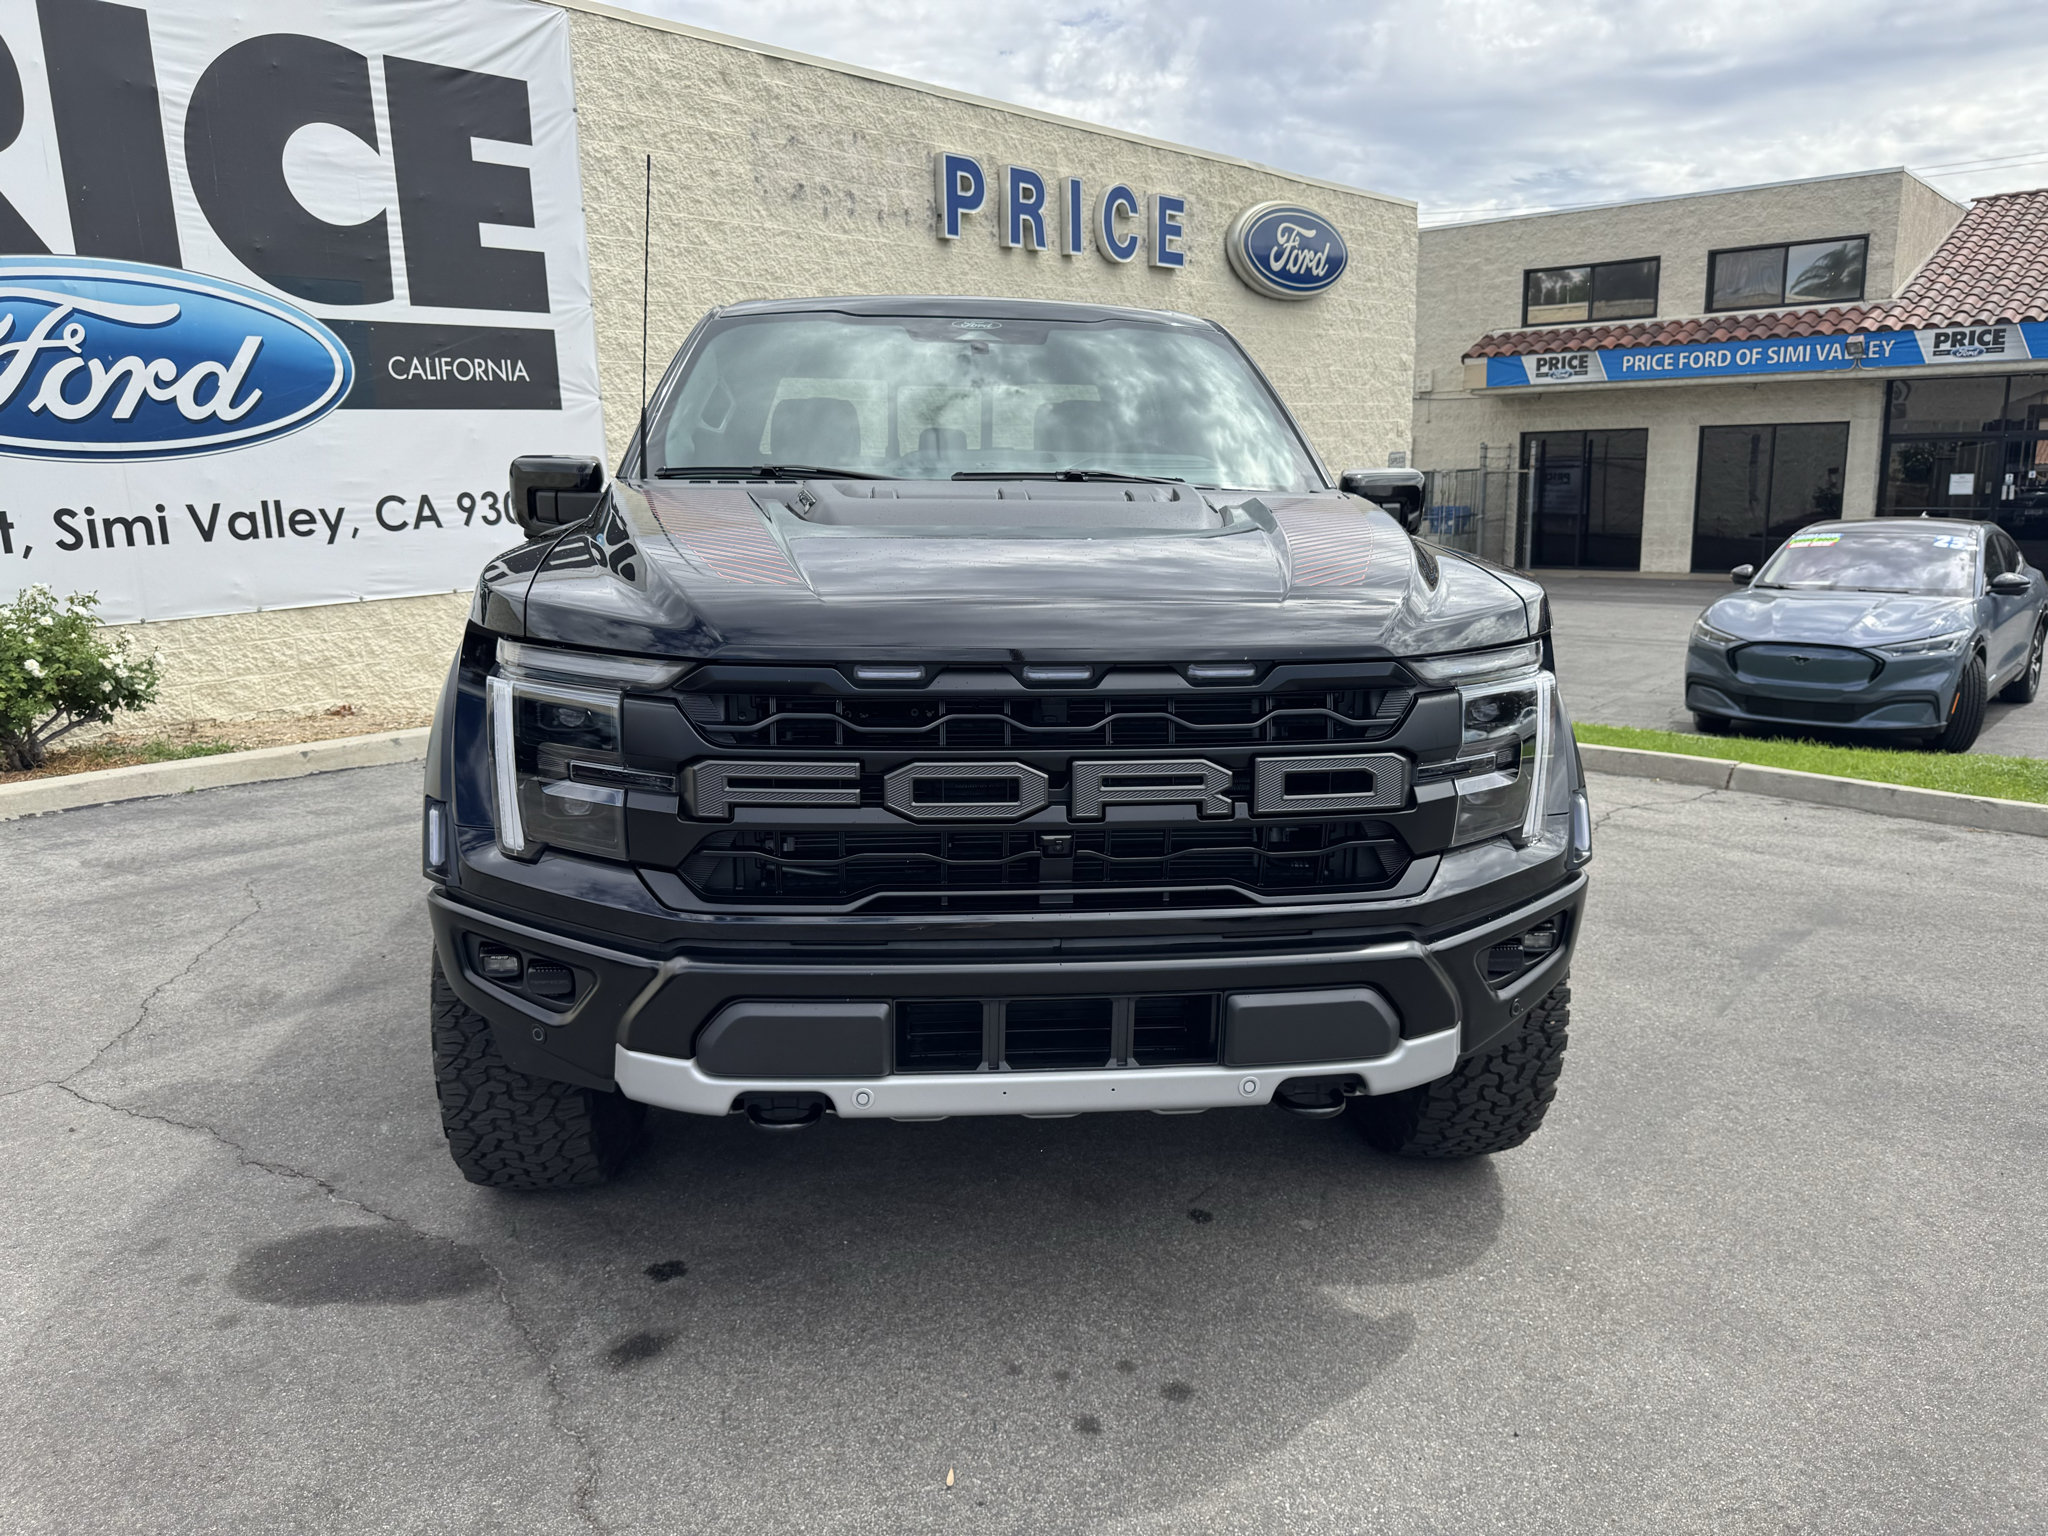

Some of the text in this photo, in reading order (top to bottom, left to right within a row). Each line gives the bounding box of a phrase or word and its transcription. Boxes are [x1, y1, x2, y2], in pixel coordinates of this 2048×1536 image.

[0, 0, 551, 313] ICE
[936, 151, 1185, 268] PRICE
[1270, 222, 1331, 278] Ford
[0, 287, 264, 421] Ford
[1536, 354, 1588, 372] PRICE
[1622, 340, 1895, 372] PRICE FORD OF SIMI VAEY
[1933, 328, 2006, 349] PRICE
[388, 356, 530, 382] CALIFORNIA
[53, 503, 170, 552] Simi
[185, 499, 360, 545] Valley,
[375, 494, 444, 532] CA
[684, 753, 1408, 820] FORD
